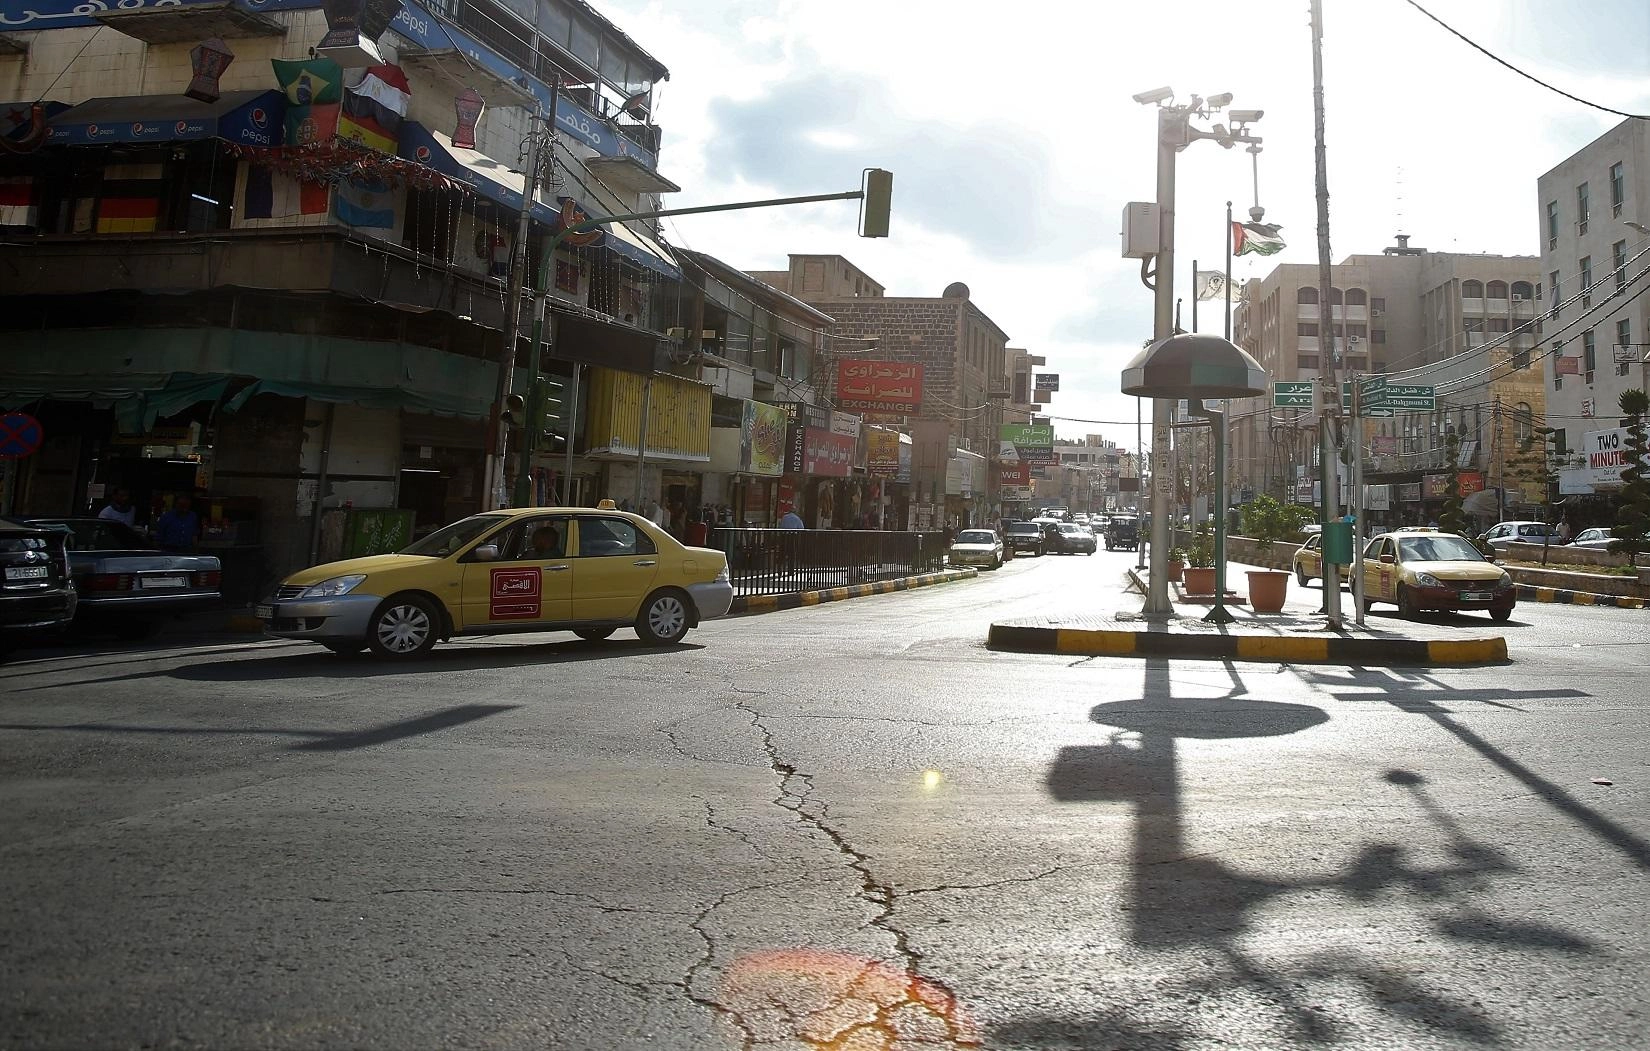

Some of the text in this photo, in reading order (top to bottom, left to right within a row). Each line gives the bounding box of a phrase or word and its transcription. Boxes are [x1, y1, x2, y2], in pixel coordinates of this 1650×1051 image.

[99, 128, 115, 136] pepsi
[143, 127, 159, 135] pepsi
[241, 126, 271, 145] pepsi
[842, 400, 913, 412] EXCHANGE
[1022, 426, 1050, 436] زمزم
[1013, 435, 1050, 447] للصرافة
[1598, 433, 1619, 450] TWO
[793, 429, 802, 472] EXCHANGE
